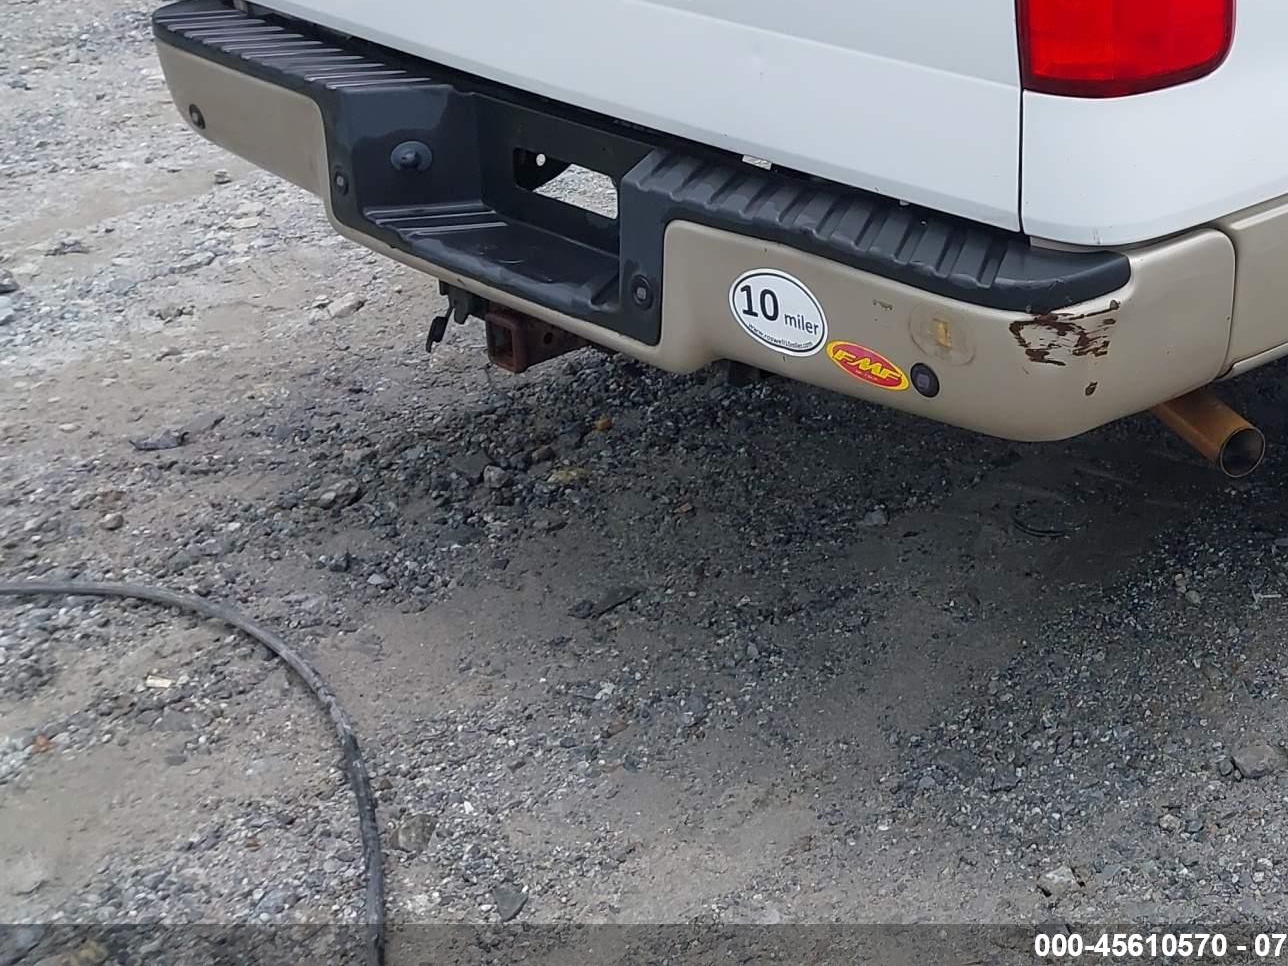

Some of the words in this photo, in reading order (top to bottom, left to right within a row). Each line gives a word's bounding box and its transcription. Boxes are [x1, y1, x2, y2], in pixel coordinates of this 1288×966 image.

[740, 284, 779, 322] 10
[784, 312, 819, 335] miler
[833, 348, 903, 381] FMF
